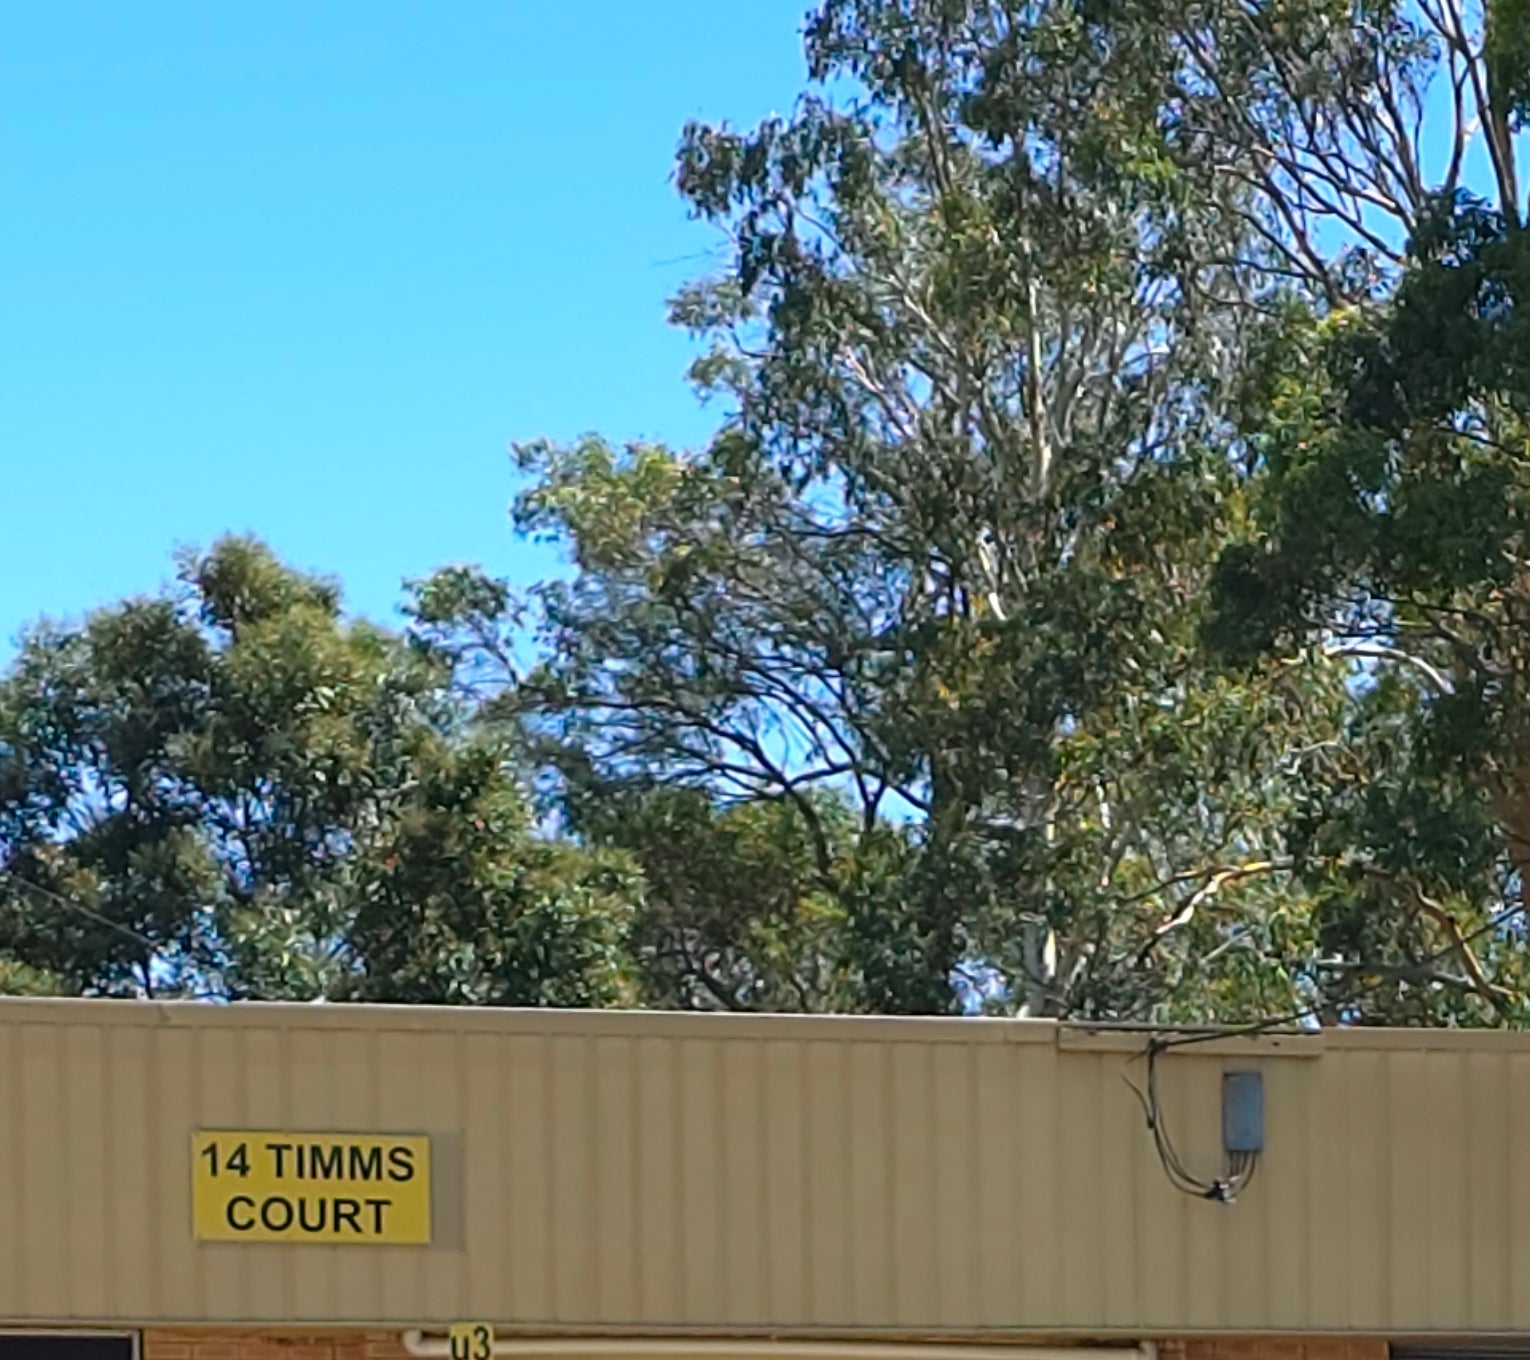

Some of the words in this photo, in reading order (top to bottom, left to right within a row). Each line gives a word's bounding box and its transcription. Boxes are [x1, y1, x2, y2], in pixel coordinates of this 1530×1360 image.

[202, 1142, 250, 1178] 14
[265, 1143, 415, 1182] TIMMS
[226, 1195, 393, 1234] COURT
